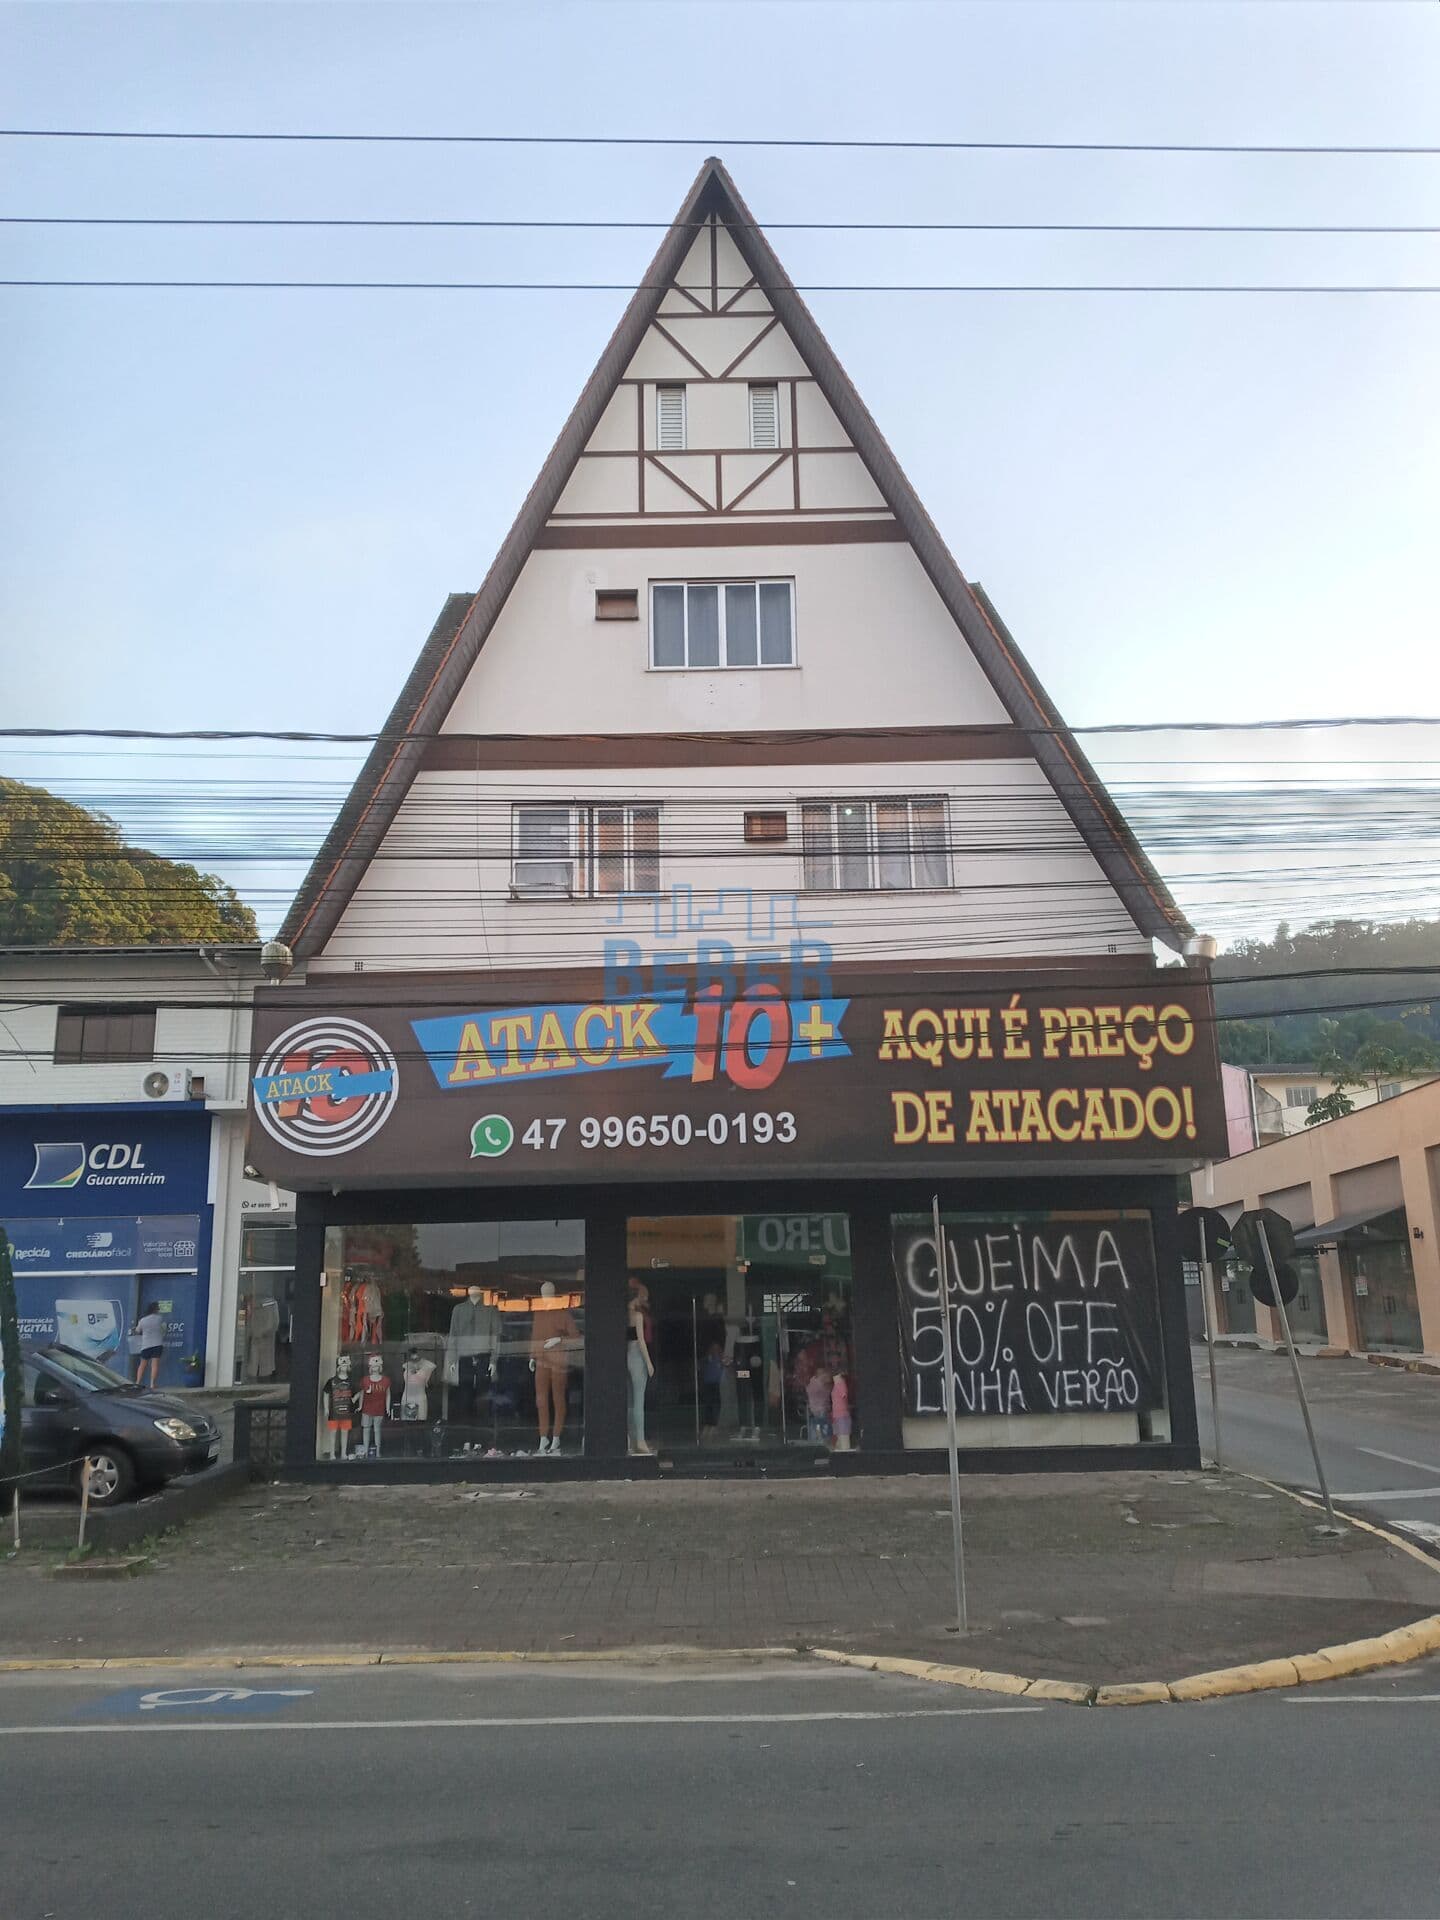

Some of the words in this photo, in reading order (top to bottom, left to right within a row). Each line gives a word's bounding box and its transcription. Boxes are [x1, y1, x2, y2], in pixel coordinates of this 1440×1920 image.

[448, 1002, 669, 1083] ATACK
[878, 1007, 994, 1067] AQUI
[1001, 993, 1031, 1059] É
[1040, 1003, 1195, 1071] PREÇO
[265, 1073, 334, 1099] ATACK
[522, 1117, 567, 1151] 47
[579, 1110, 798, 1150] 99650-0193
[891, 1089, 955, 1144] DE
[965, 1086, 1198, 1144] ATACADO!
[86, 1172, 166, 1186] Guaramirim
[88, 1143, 146, 1170] CDL
[906, 1223, 1130, 1298] QUEIMA
[17, 1324, 54, 1333] IGITAL
[167, 1322, 185, 1332] SPC
[911, 1299, 1014, 1370] 50%
[1025, 1300, 1120, 1364] OFF
[915, 1366, 1030, 1414] LINHA
[1039, 1356, 1140, 1410] VERÃO
